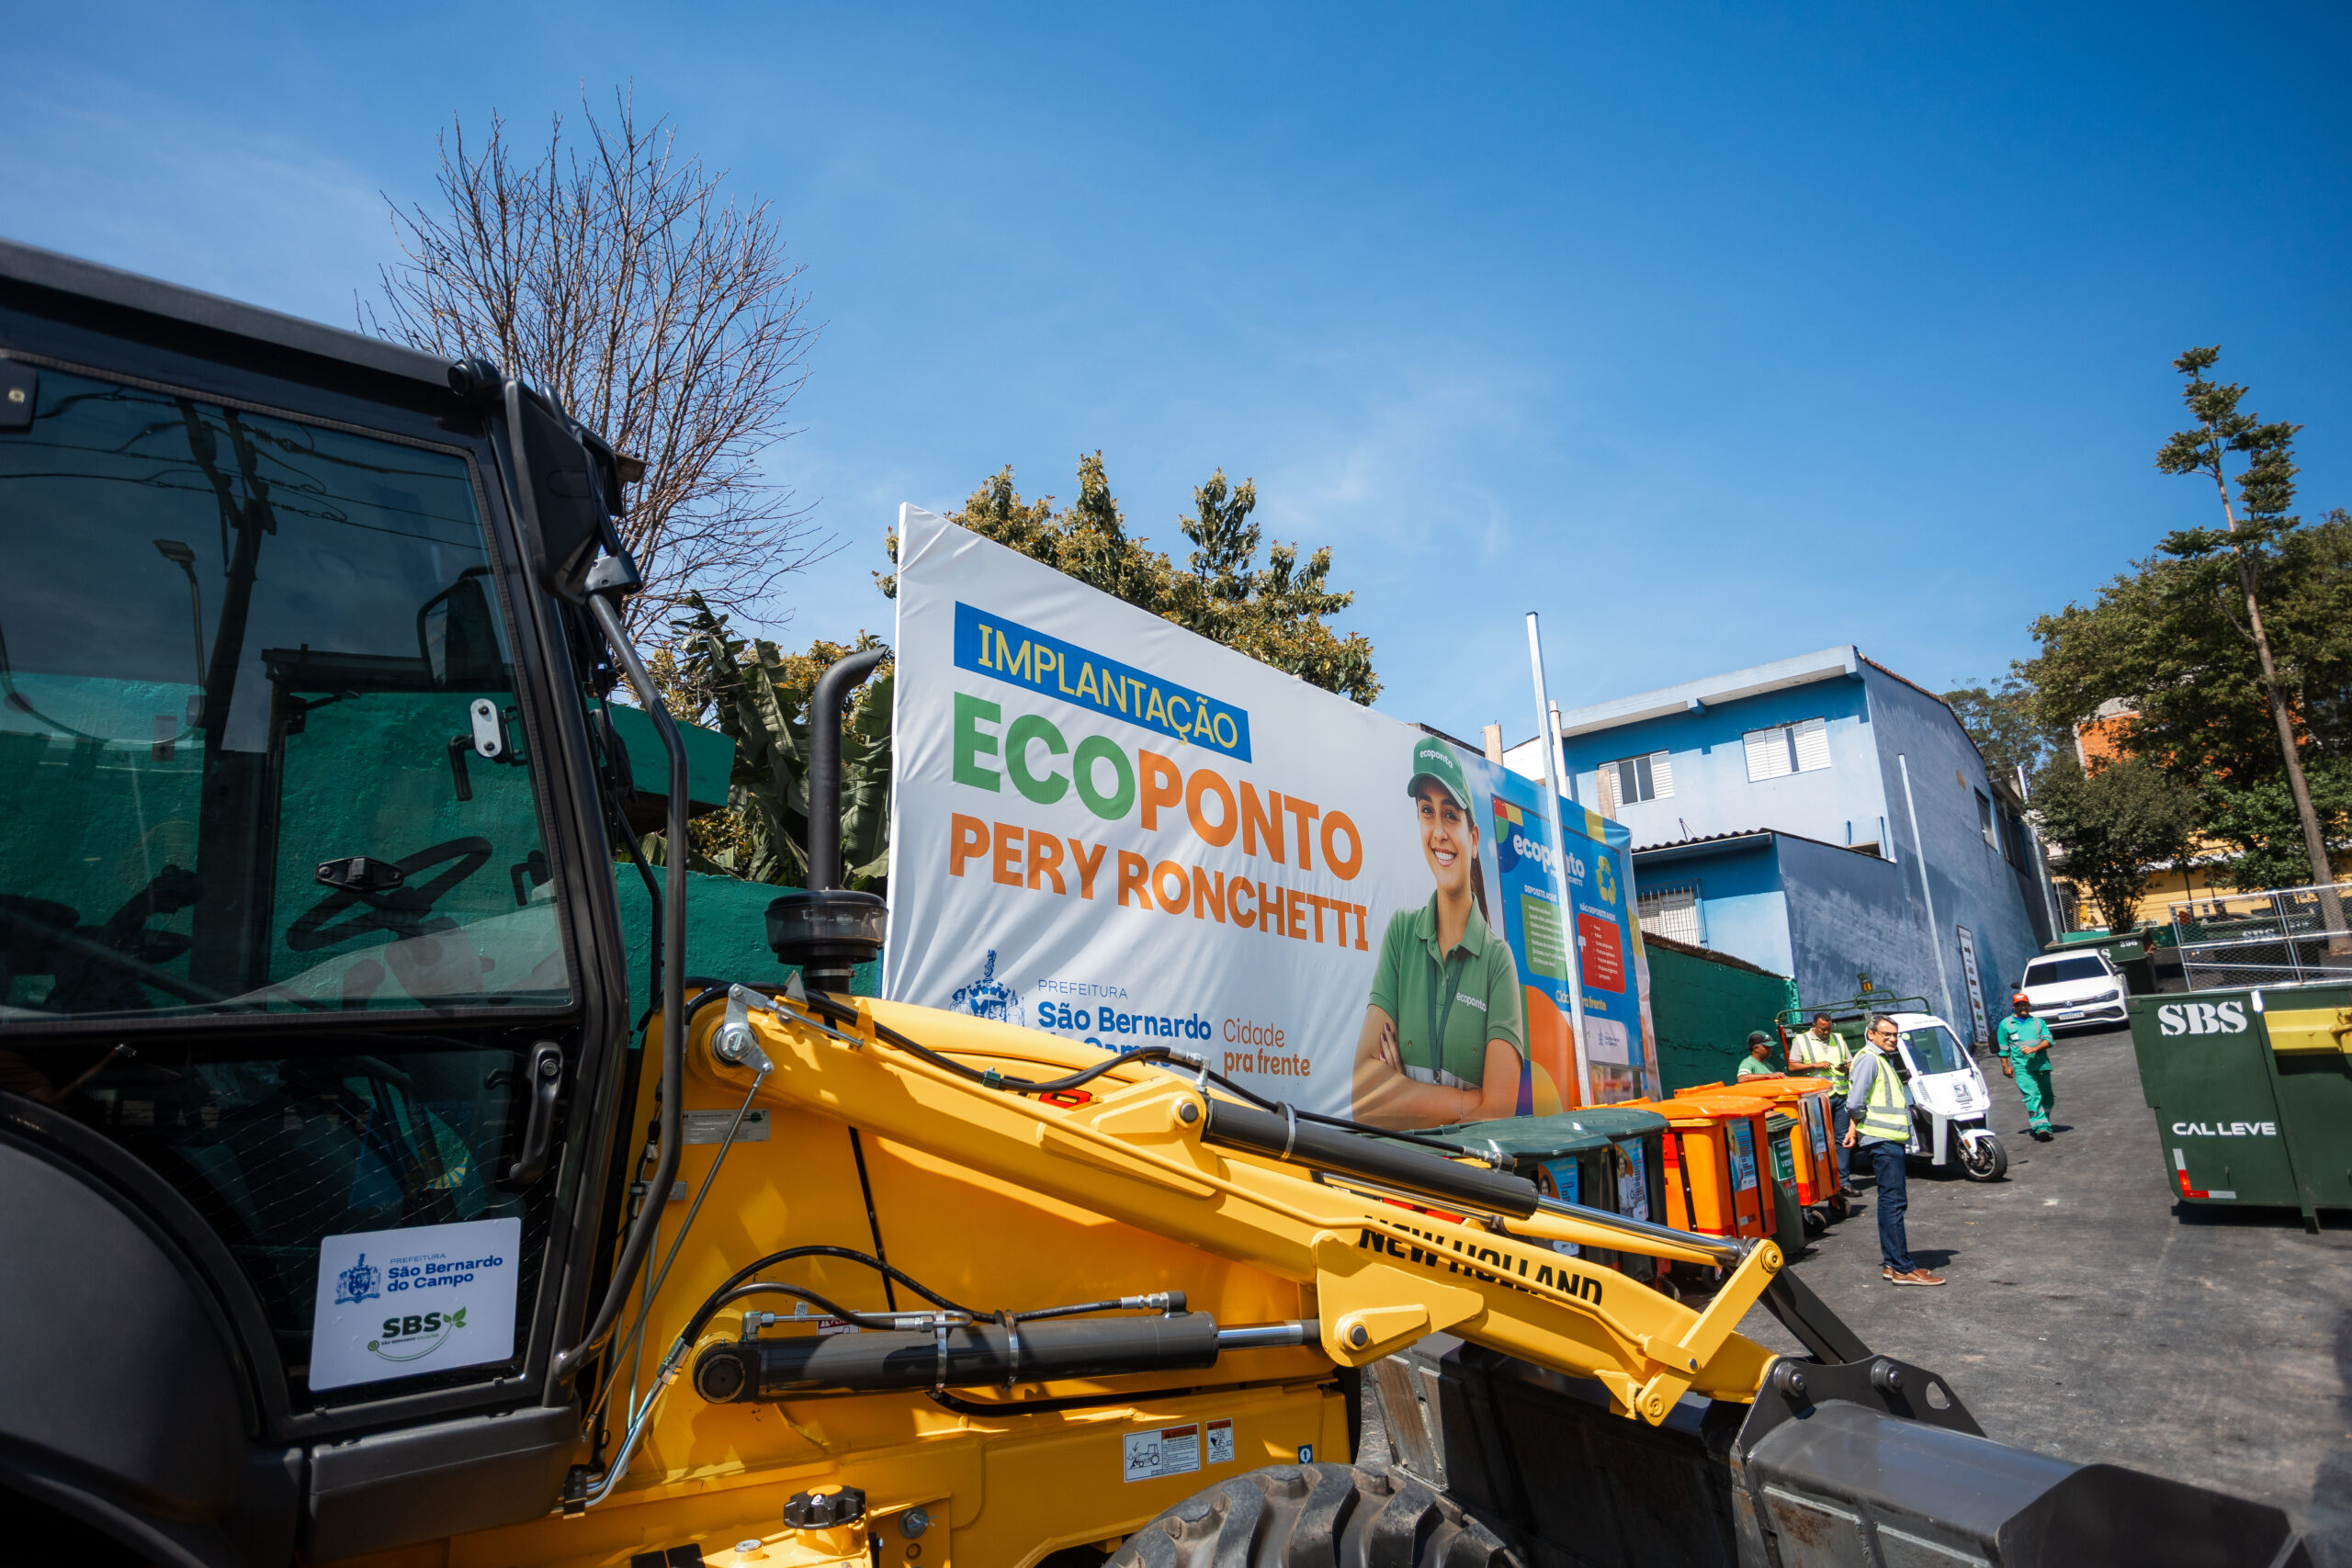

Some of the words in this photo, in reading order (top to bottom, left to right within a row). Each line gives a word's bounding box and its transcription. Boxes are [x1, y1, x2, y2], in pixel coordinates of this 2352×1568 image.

[978, 624, 1238, 749] IMPLANTAÇÃO
[1419, 748, 1453, 770] ecoponto
[953, 692, 1363, 880] ECOPONTO
[950, 812, 1108, 900] PERY
[1118, 849, 1369, 952] RONCHETTI
[1038, 979, 1128, 999] PREFEITURA
[1456, 992, 1487, 1012] ecoponto
[1037, 1001, 1091, 1031] São
[1098, 1006, 1212, 1041] Bernardo
[2158, 1000, 2248, 1036] SBS
[1223, 1018, 1285, 1048] Cidade
[1223, 1052, 1253, 1078] pra
[1258, 1049, 1310, 1077] frente
[388, 1262, 421, 1280] São
[425, 1255, 503, 1274] Bernardo
[390, 1253, 447, 1264] PREFEITURA
[1359, 1214, 1445, 1268] NEW
[1449, 1240, 1602, 1307] HOLLAND
[387, 1279, 409, 1292] do
[413, 1273, 474, 1289] Campo
[382, 1312, 442, 1338] SBS
